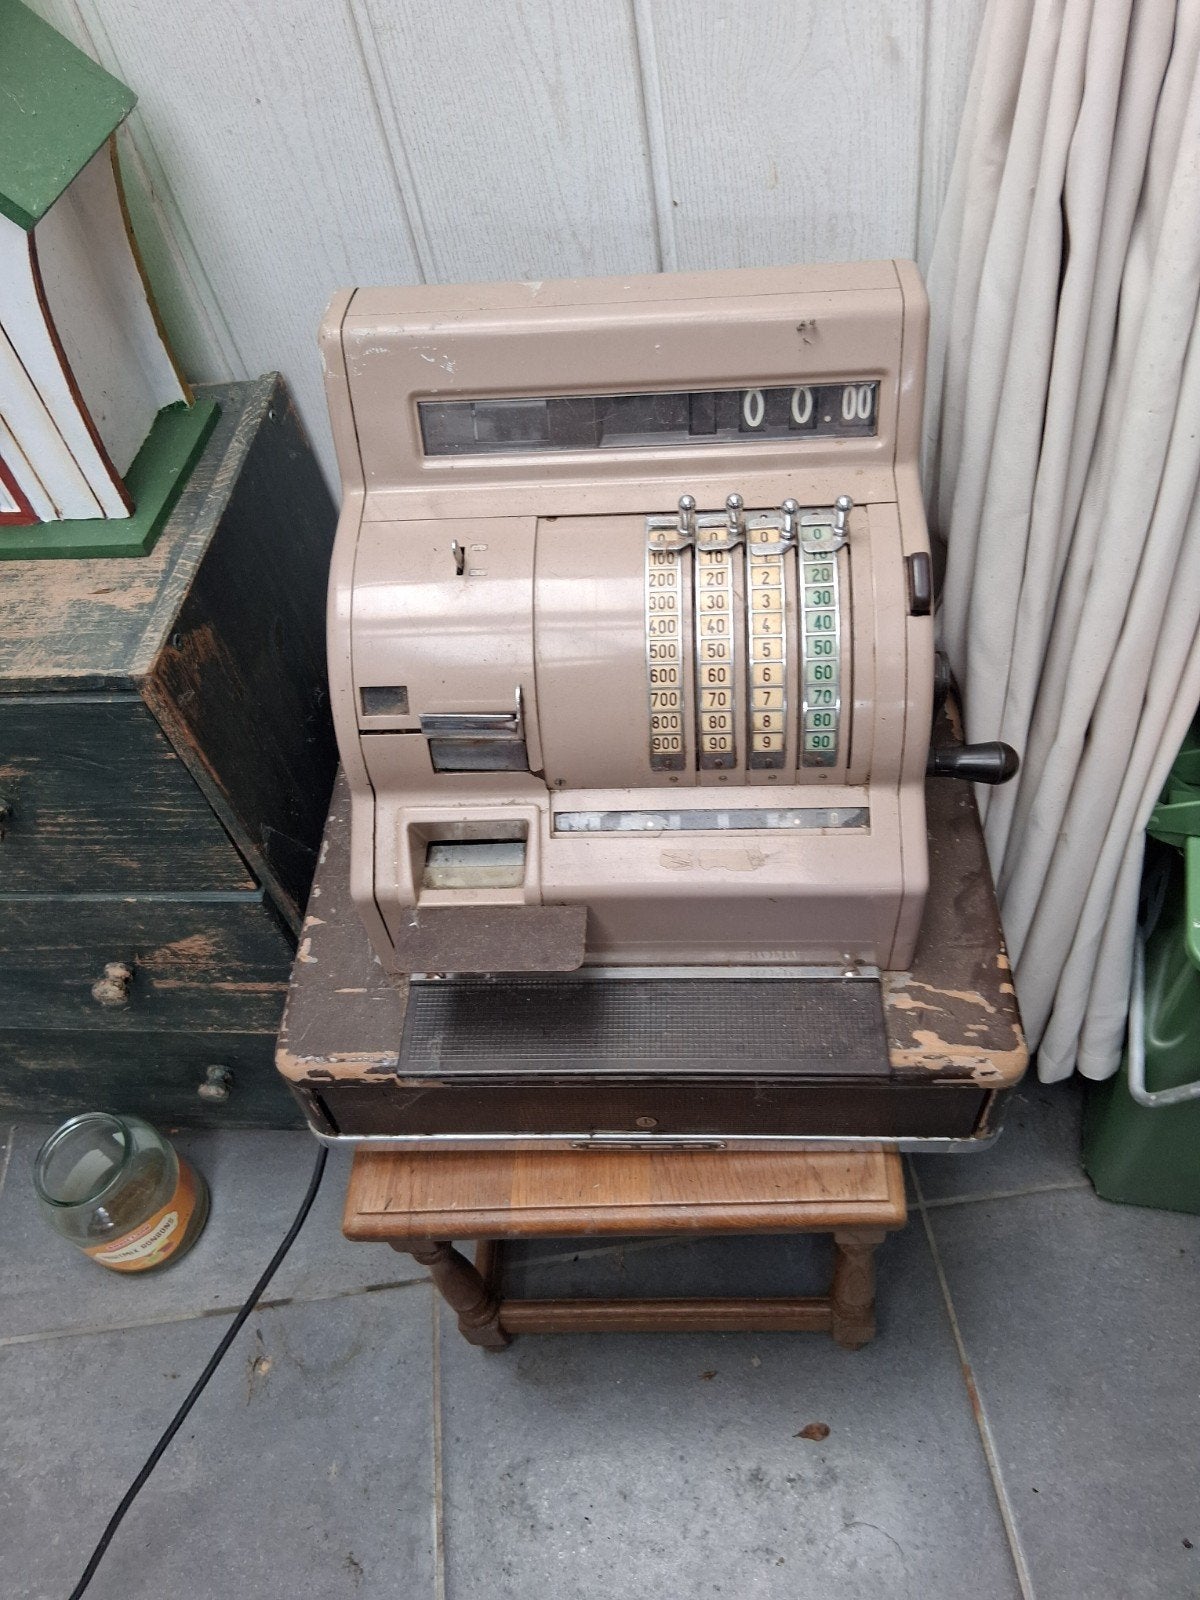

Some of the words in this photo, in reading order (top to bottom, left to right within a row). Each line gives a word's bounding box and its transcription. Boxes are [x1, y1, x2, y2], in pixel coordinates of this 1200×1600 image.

[743, 389, 764, 427] 0
[760, 532, 769, 542] 0
[814, 529, 822, 539] 0
[653, 553, 674, 564] 100
[708, 551, 723, 563] 10
[649, 572, 675, 586] 200
[707, 572, 724, 585] 20
[761, 571, 770, 584] 2
[812, 569, 831, 582] 20
[649, 595, 675, 609] 300
[707, 595, 724, 608] 30
[762, 594, 770, 608] 3
[813, 591, 831, 604] 30
[649, 619, 675, 633] 400
[707, 619, 724, 633] 40
[762, 619, 770, 632] 4
[814, 615, 831, 629] 40
[650, 644, 676, 658] 500
[708, 643, 725, 657] 50
[763, 643, 770, 656] 5
[814, 640, 831, 654] 50
[650, 668, 677, 682] 600
[708, 668, 725, 682] 60
[763, 668, 771, 681] 6
[815, 666, 832, 679] 60
[651, 693, 677, 706] 700
[709, 693, 726, 706] 70
[763, 692, 771, 705] 7
[814, 690, 831, 703] 70
[652, 716, 678, 729] 800
[709, 716, 726, 728] 80
[763, 715, 770, 727] 8
[813, 713, 831, 726] 80
[653, 737, 678, 750] 900
[709, 737, 726, 750] 90
[763, 737, 770, 747] 9
[812, 736, 830, 748] 90
